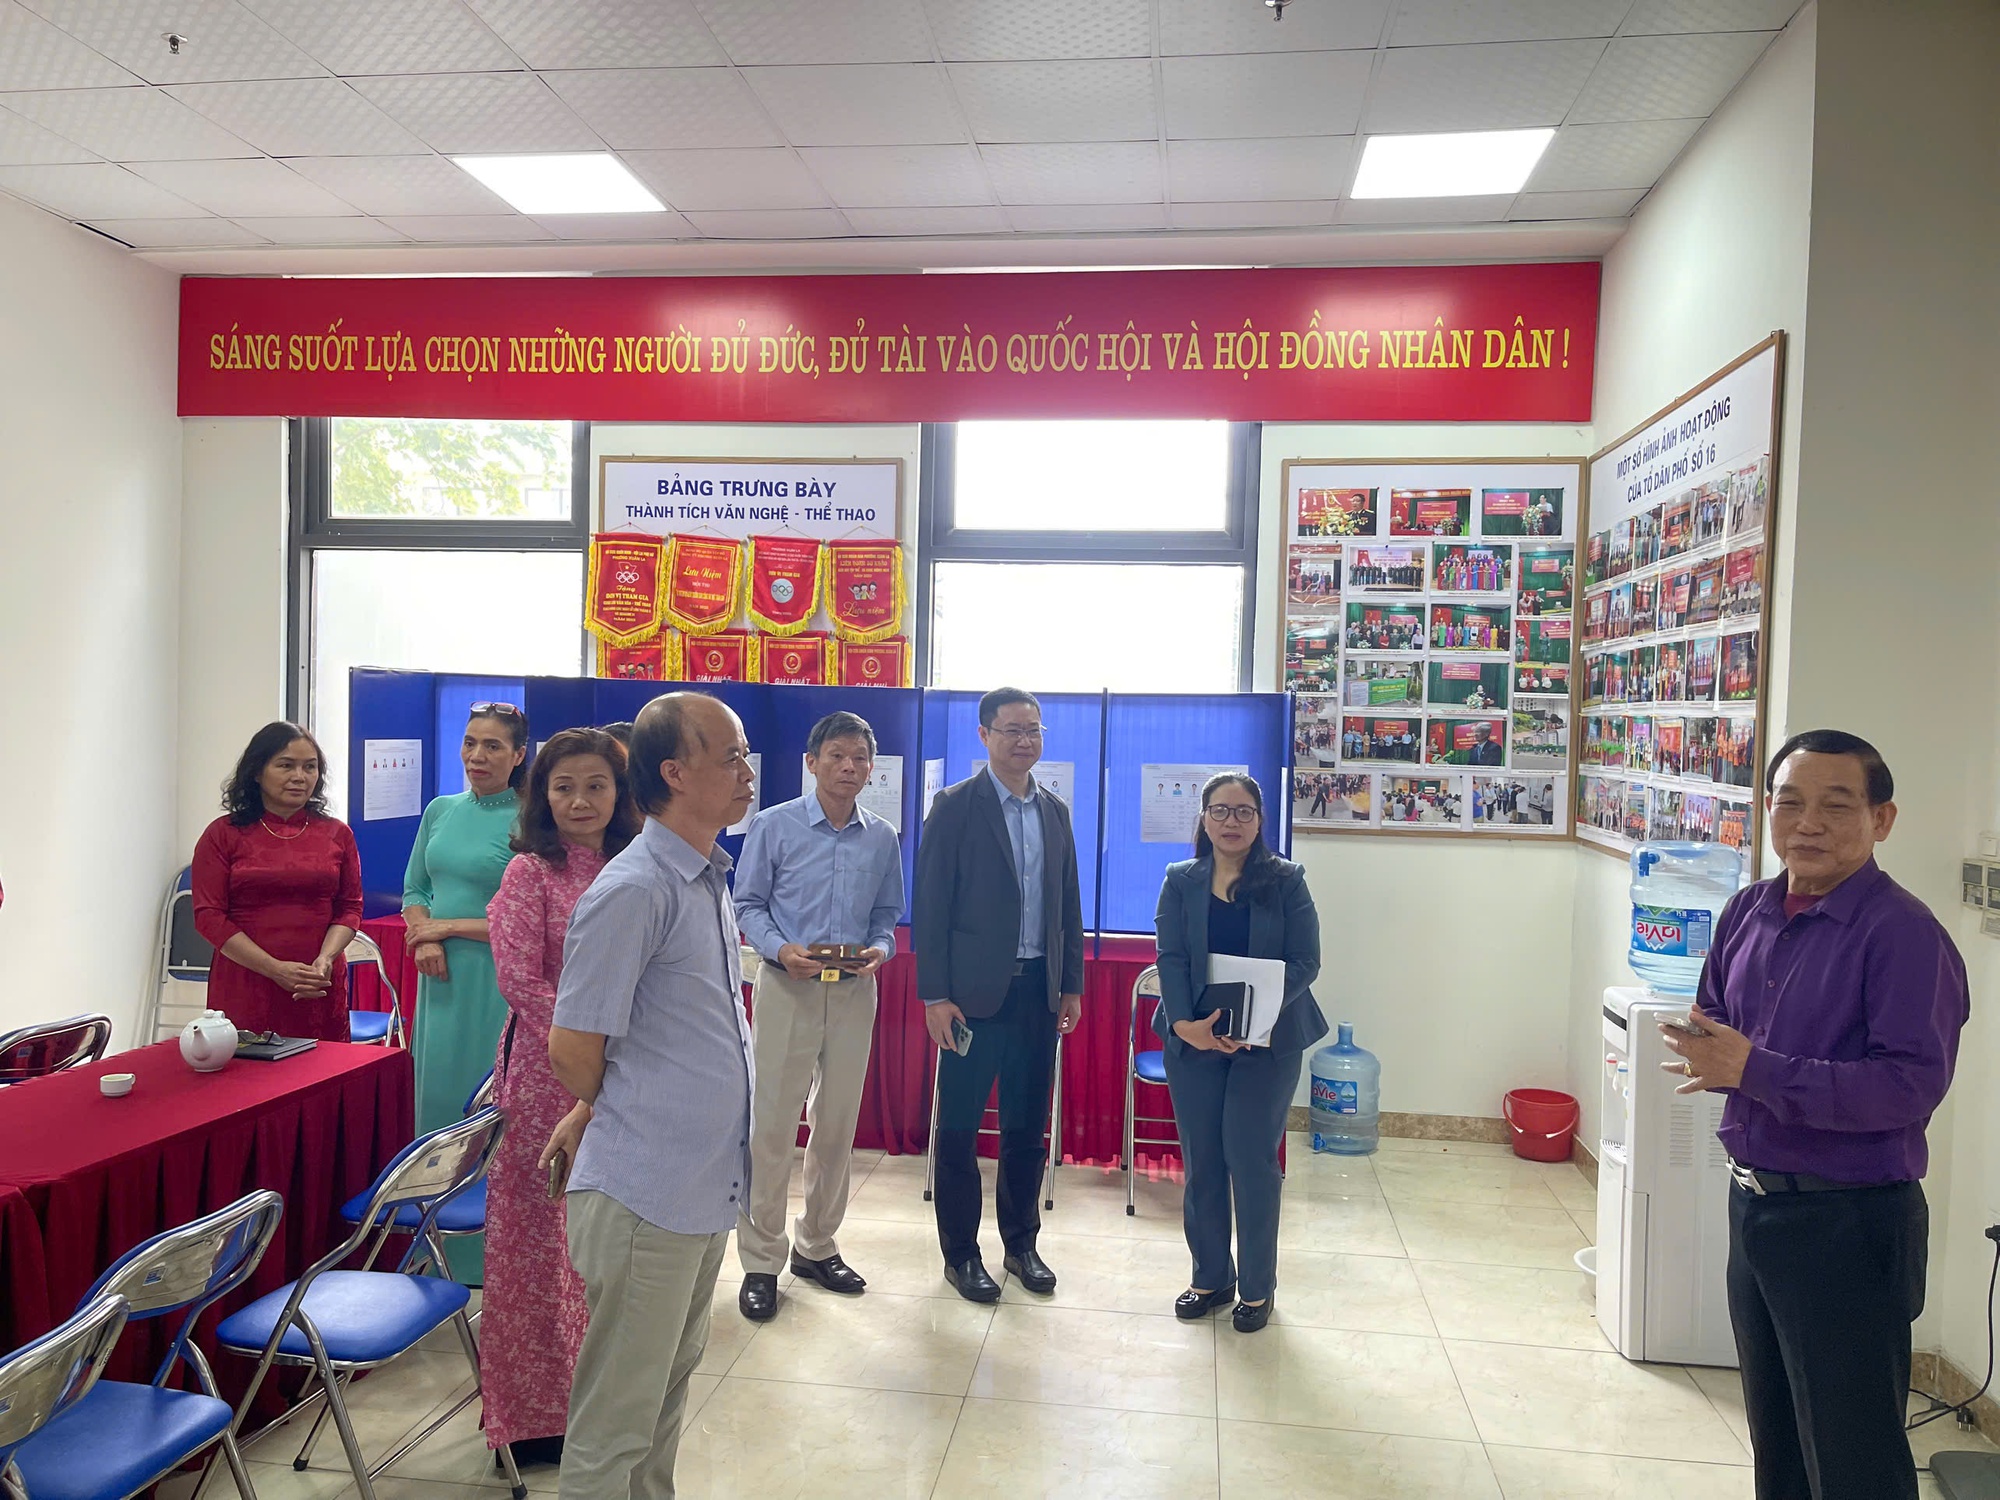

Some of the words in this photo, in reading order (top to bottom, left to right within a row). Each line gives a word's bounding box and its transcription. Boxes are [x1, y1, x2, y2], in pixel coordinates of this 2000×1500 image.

[211, 323, 282, 370] SÁNG
[290, 318, 358, 371] SUỐT
[366, 331, 416, 382] LỰA
[425, 336, 501, 382] CHỌN
[508, 328, 606, 374] NHỮNG
[614, 325, 702, 374] NGƯỜI
[711, 319, 750, 373] ĐỦ
[759, 325, 820, 379] ĐỨC,
[829, 318, 869, 373] ĐỦ
[878, 324, 927, 373] TÀI
[937, 324, 998, 373] VÀO
[1006, 315, 1088, 375] QUỐC
[1097, 320, 1152, 381] HỘI
[1161, 321, 1202, 371] VÀ
[1212, 318, 1269, 380] HỘI
[1278, 310, 1370, 370] ĐỒNG
[1377, 316, 1474, 370] NHÂN
[1481, 315, 1555, 370] DÂN
[1562, 329, 1570, 369] !
[1617, 454, 1632, 481] MỘT
[1632, 440, 1642, 471] SỐ
[1642, 439, 1660, 465] HÌNH
[1660, 427, 1677, 454] ẢNH
[1680, 412, 1703, 443] HOẠT
[1704, 396, 1731, 432] ĐỘNG
[657, 472, 713, 496] BẢNG
[719, 479, 788, 498] TRƯNG
[795, 477, 837, 498] BÀY
[1627, 476, 1642, 503] CỦA
[1643, 465, 1653, 496] TỔ
[1654, 465, 1671, 491] DÂN
[1671, 447, 1690, 482] PHỐ
[1691, 439, 1704, 475] SỐ
[1706, 443, 1716, 466] 16
[625, 502, 673, 519] THÀNH
[678, 503, 710, 519] TÍCH
[715, 504, 745, 520] VĂN
[749, 505, 788, 523] NGHỆ
[804, 501, 832, 520] THỂ
[836, 508, 876, 521] THAO
